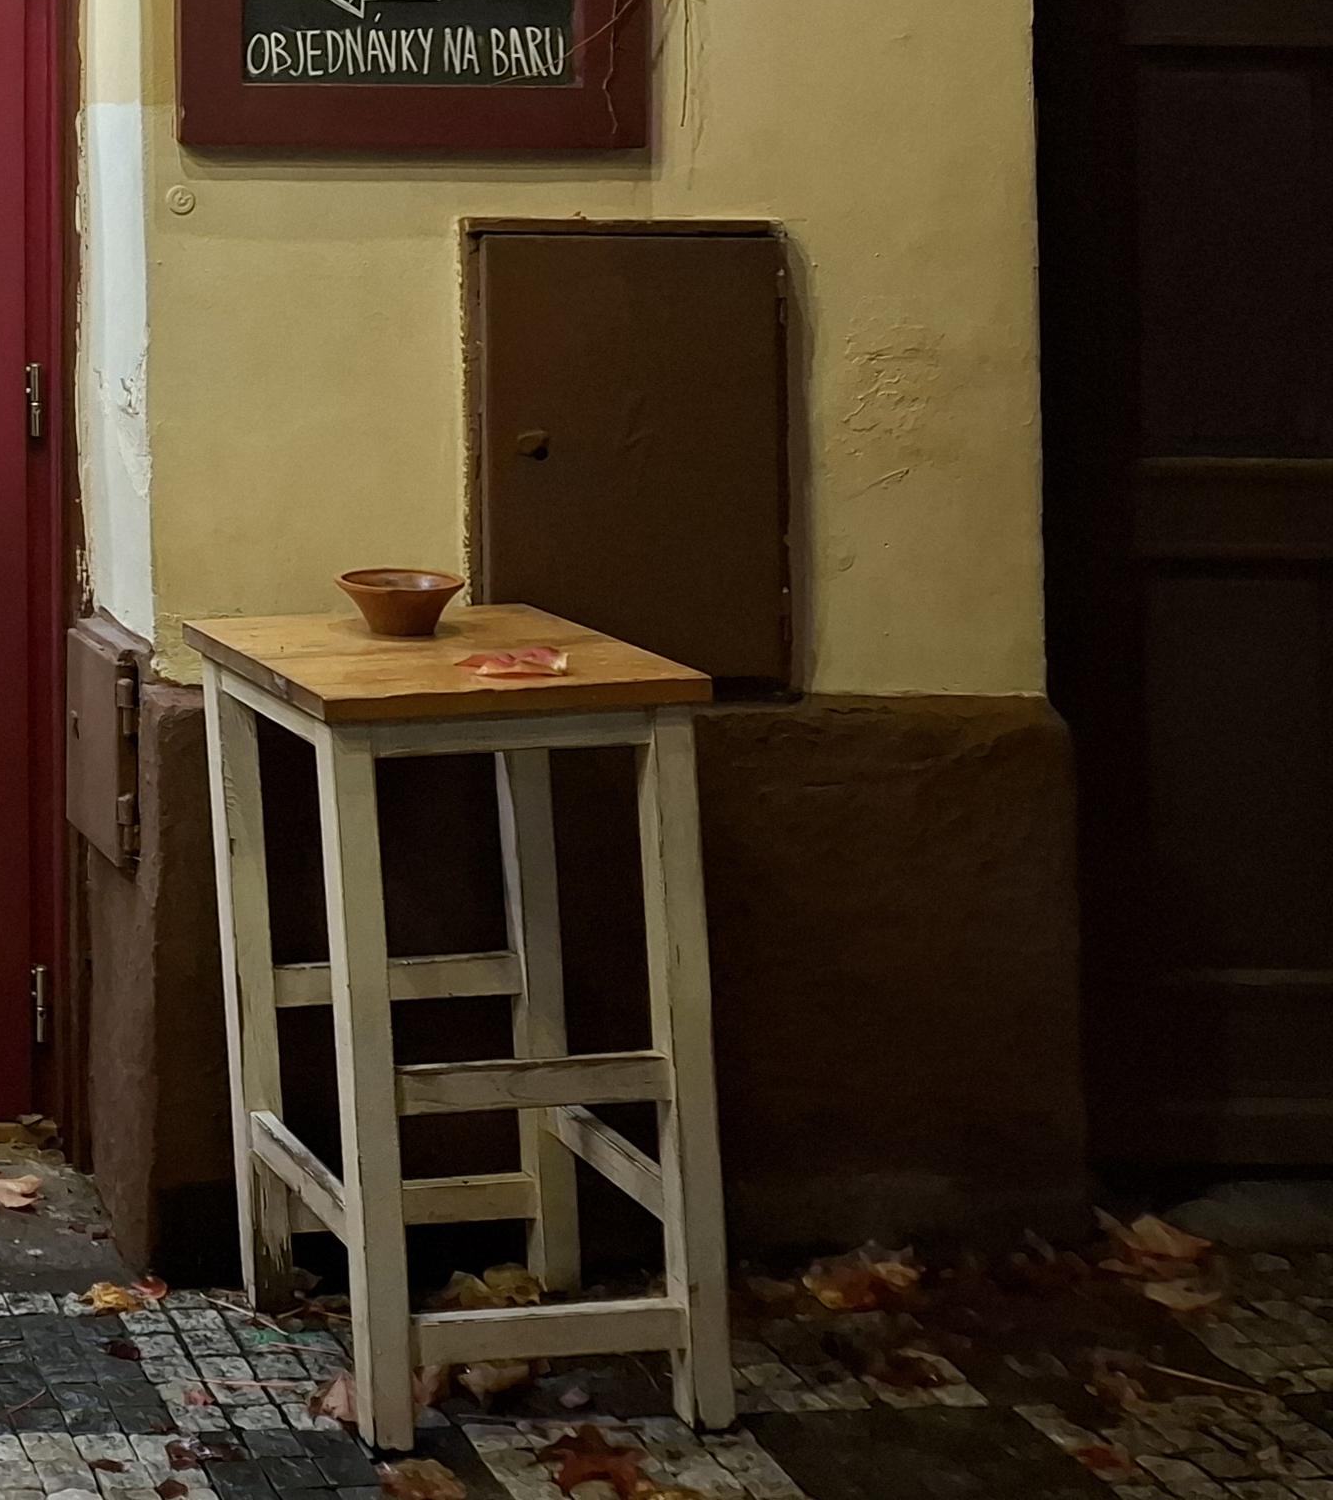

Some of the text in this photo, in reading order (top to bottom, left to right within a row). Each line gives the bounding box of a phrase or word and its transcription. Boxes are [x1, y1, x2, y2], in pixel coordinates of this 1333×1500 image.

[247, 13, 565, 76] OBJEDNÁVKY NA BARU
